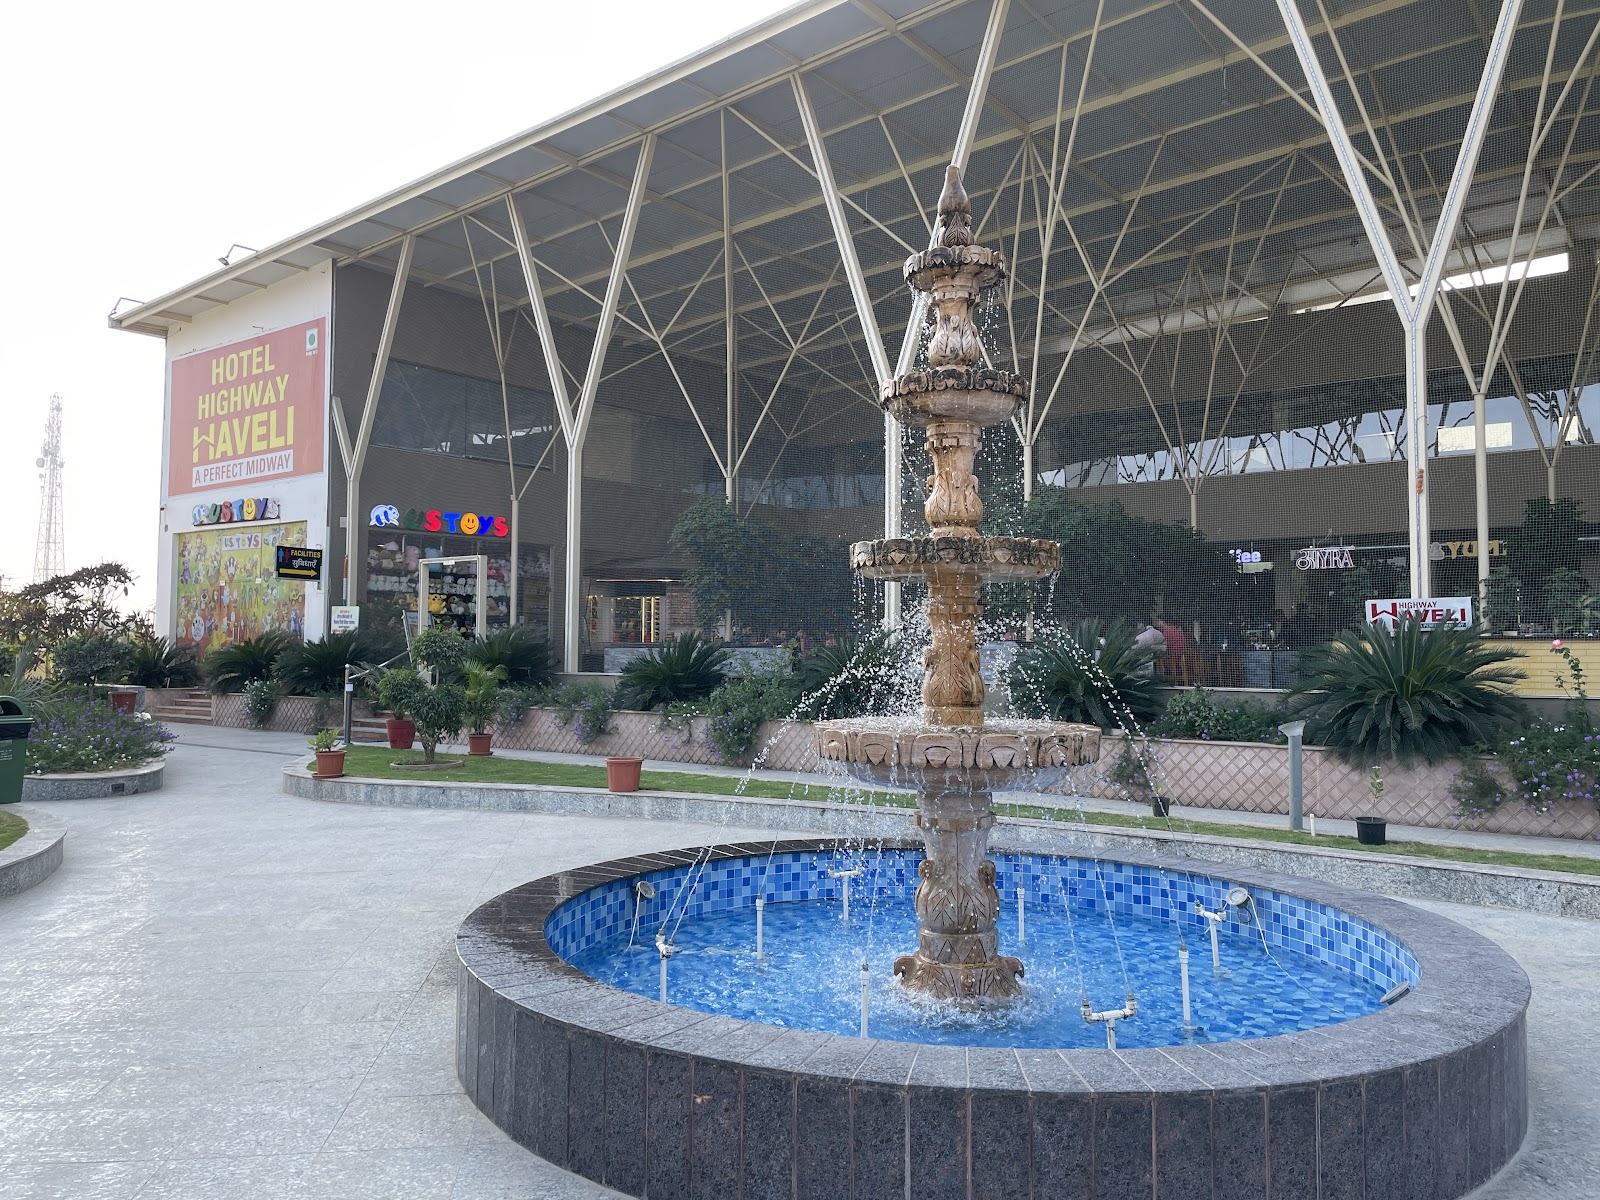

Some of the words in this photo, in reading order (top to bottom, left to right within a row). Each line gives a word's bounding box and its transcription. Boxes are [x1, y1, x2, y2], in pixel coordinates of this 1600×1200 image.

[211, 344, 276, 385] HOTEL
[197, 374, 289, 420] HIGHWAY
[192, 405, 294, 463] HAVELI
[194, 470, 201, 484] A
[203, 462, 244, 482] PERFECT
[246, 453, 291, 476] MIDWAY
[290, 549, 321, 558] FACILITIES
[1399, 601, 1438, 609] HIGHWAY
